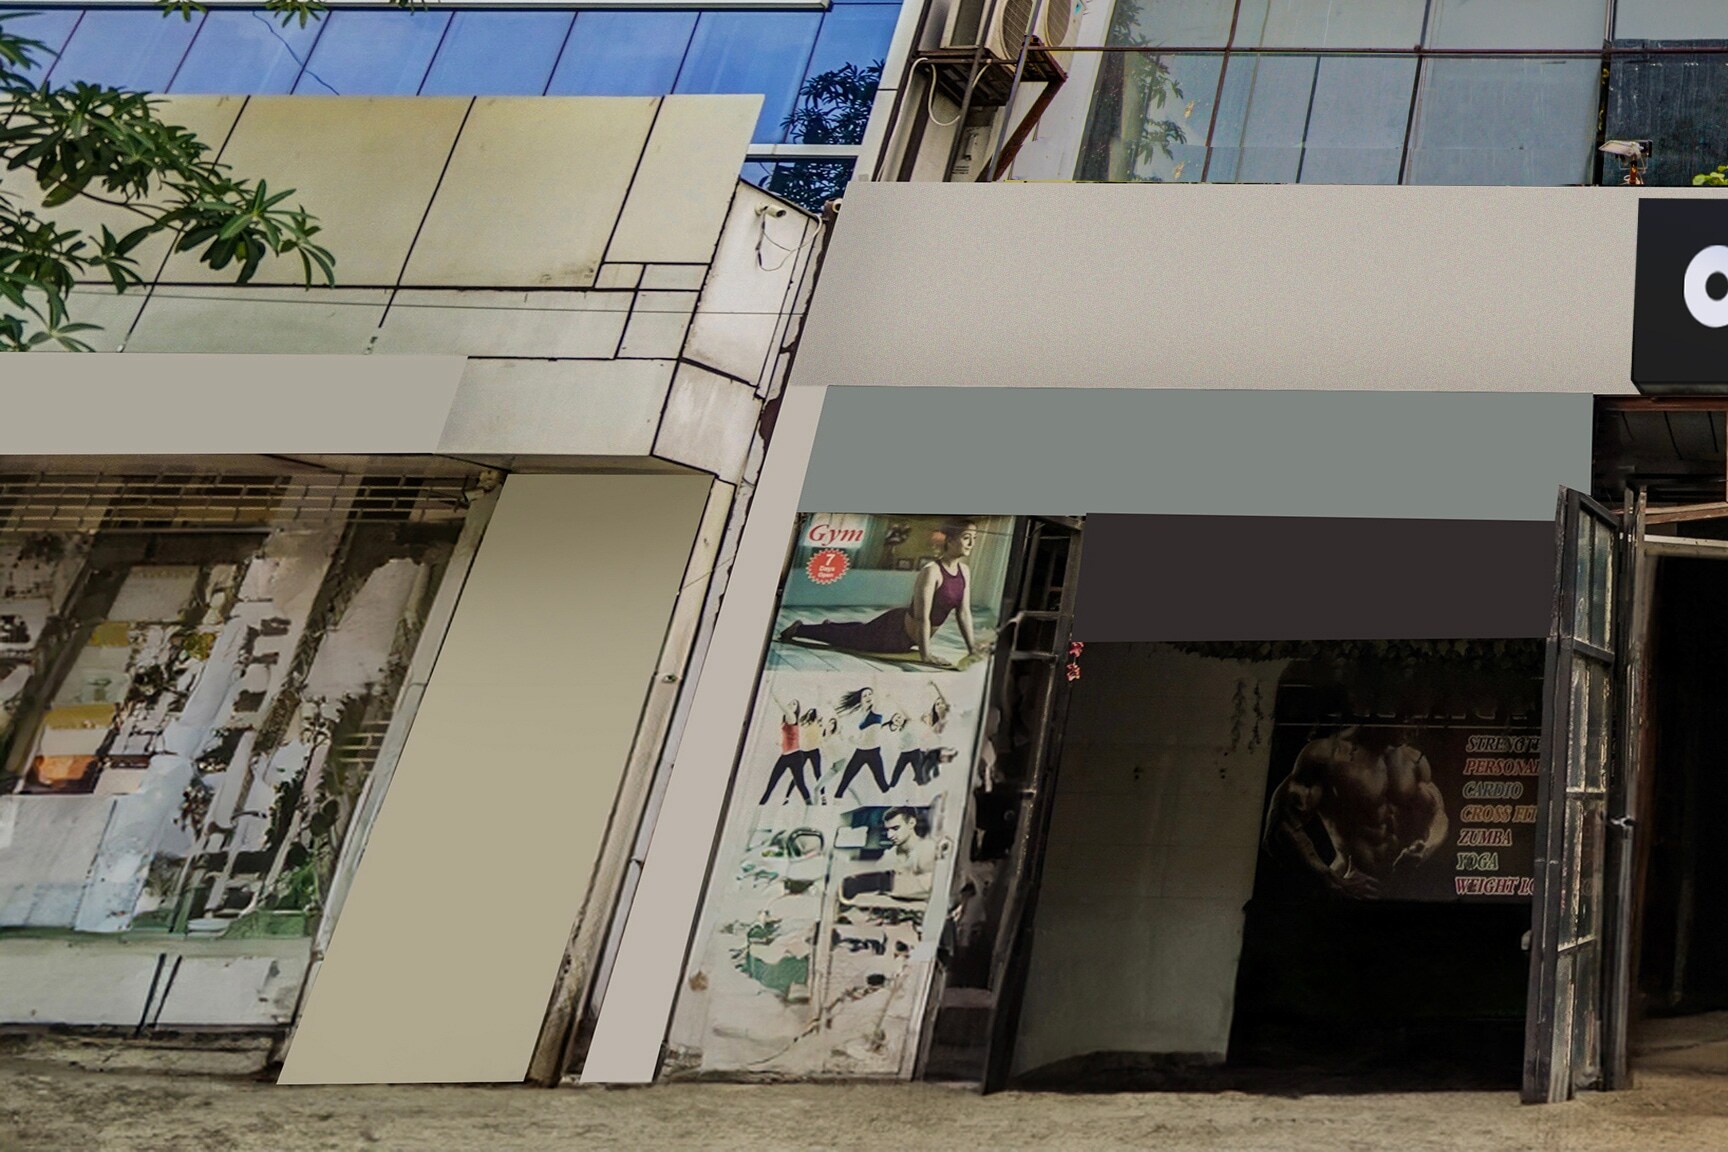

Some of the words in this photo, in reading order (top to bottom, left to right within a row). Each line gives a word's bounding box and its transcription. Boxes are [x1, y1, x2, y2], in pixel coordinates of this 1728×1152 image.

[809, 524, 863, 546] Gym
[825, 553, 836, 566] 7
[1462, 781, 1523, 799] CARDIO
[1461, 805, 1512, 823] CROSS
[1457, 829, 1512, 846] ZUMBA
[1456, 852, 1499, 870] YOGA
[1455, 876, 1519, 895] WEIGHT
